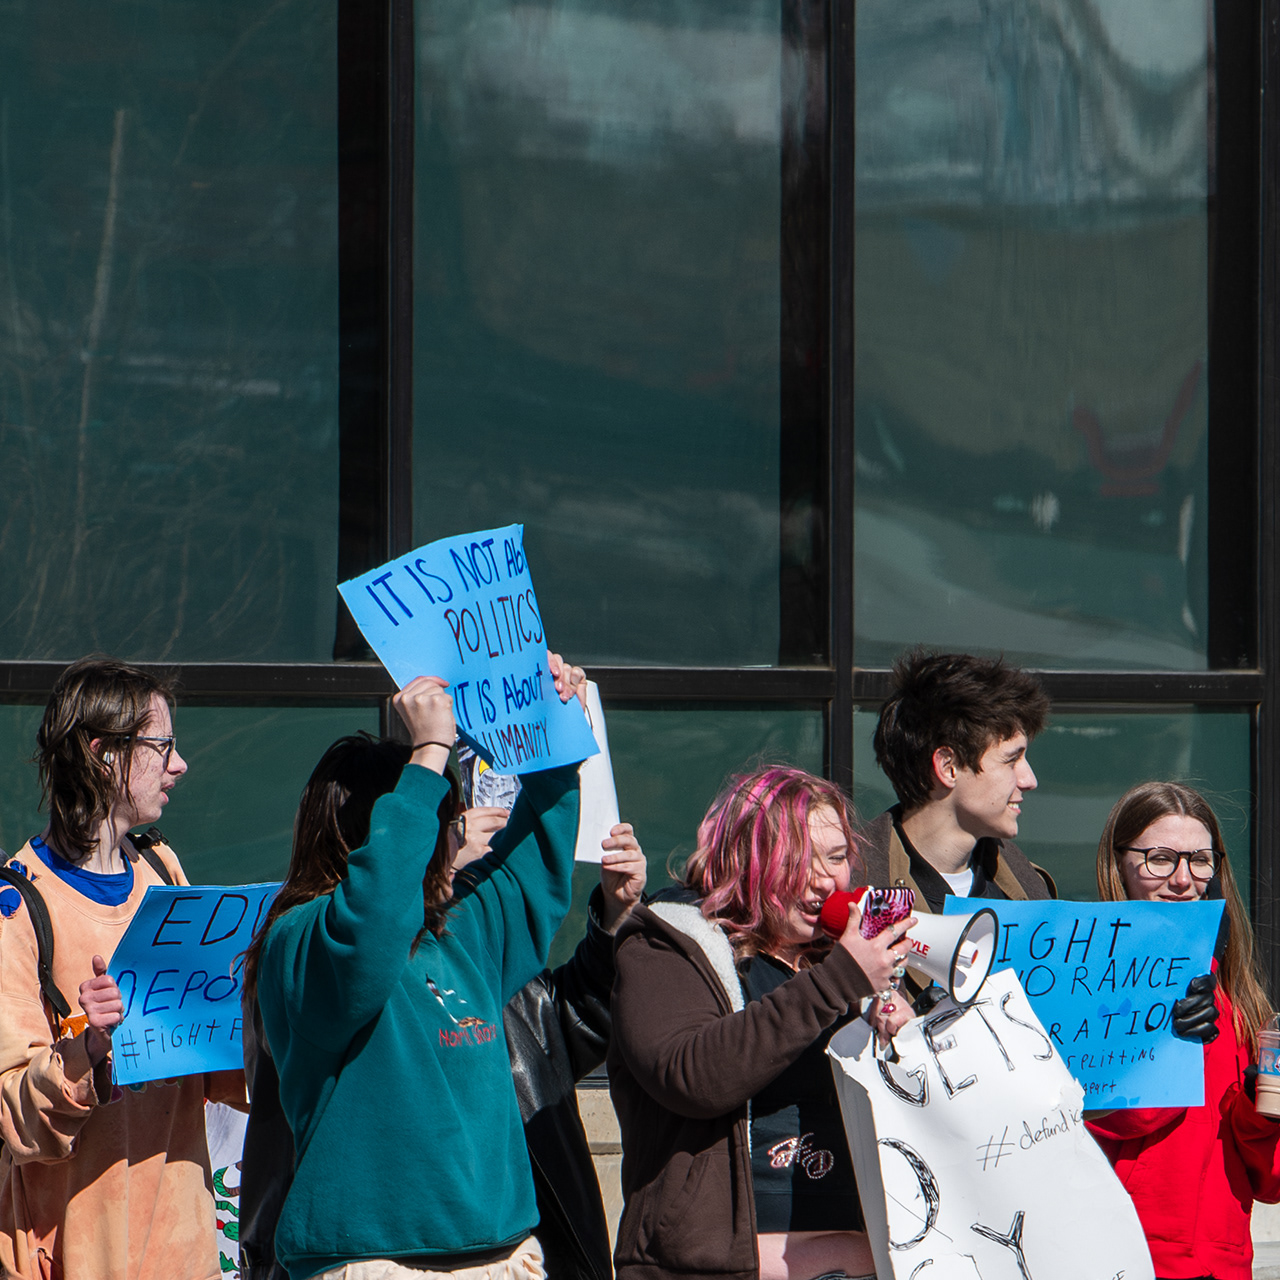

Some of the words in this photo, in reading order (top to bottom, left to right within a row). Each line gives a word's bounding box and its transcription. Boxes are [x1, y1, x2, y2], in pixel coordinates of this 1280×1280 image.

[365, 571, 414, 627] IT
[404, 558, 454, 604] IS
[449, 538, 500, 592] NOT
[444, 588, 543, 665] POLITICS
[450, 681, 473, 731] IT
[476, 679, 497, 724] IS
